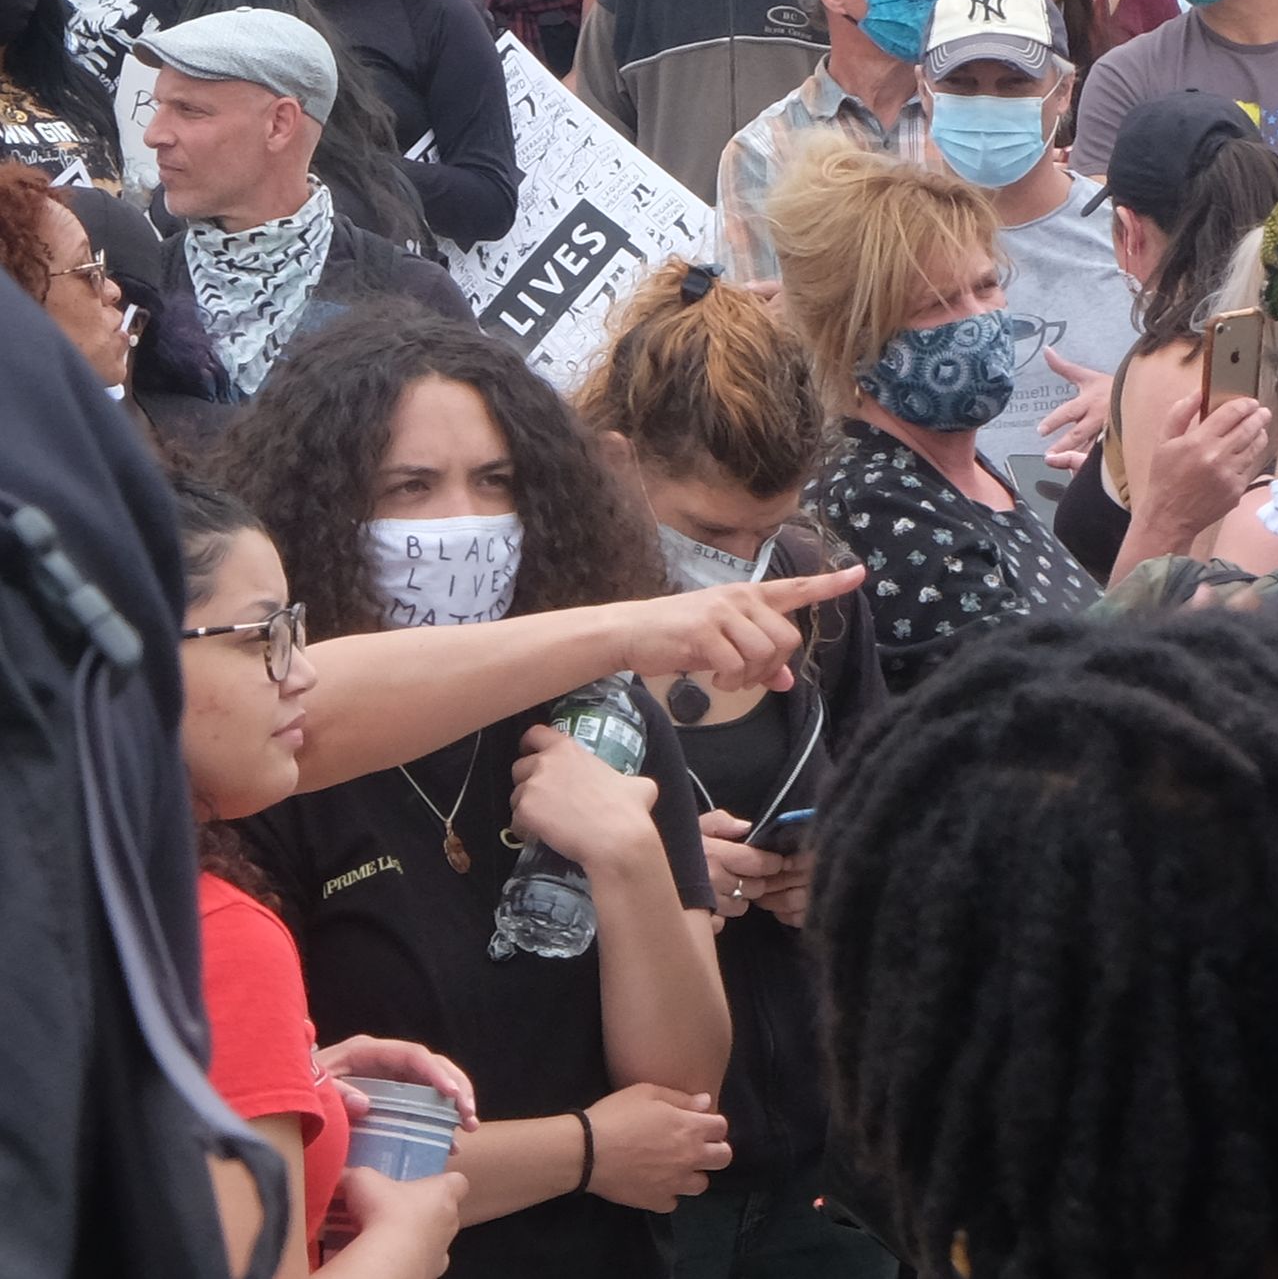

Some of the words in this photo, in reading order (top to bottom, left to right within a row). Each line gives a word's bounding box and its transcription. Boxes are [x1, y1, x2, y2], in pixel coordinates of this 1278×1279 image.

[0, 123, 39, 145] WN
[500, 222, 607, 336] LIVES
[1011, 385, 1050, 400] mell
[406, 534, 517, 562] BLACK
[694, 543, 737, 570] BLACK
[407, 565, 513, 598] LIVES
